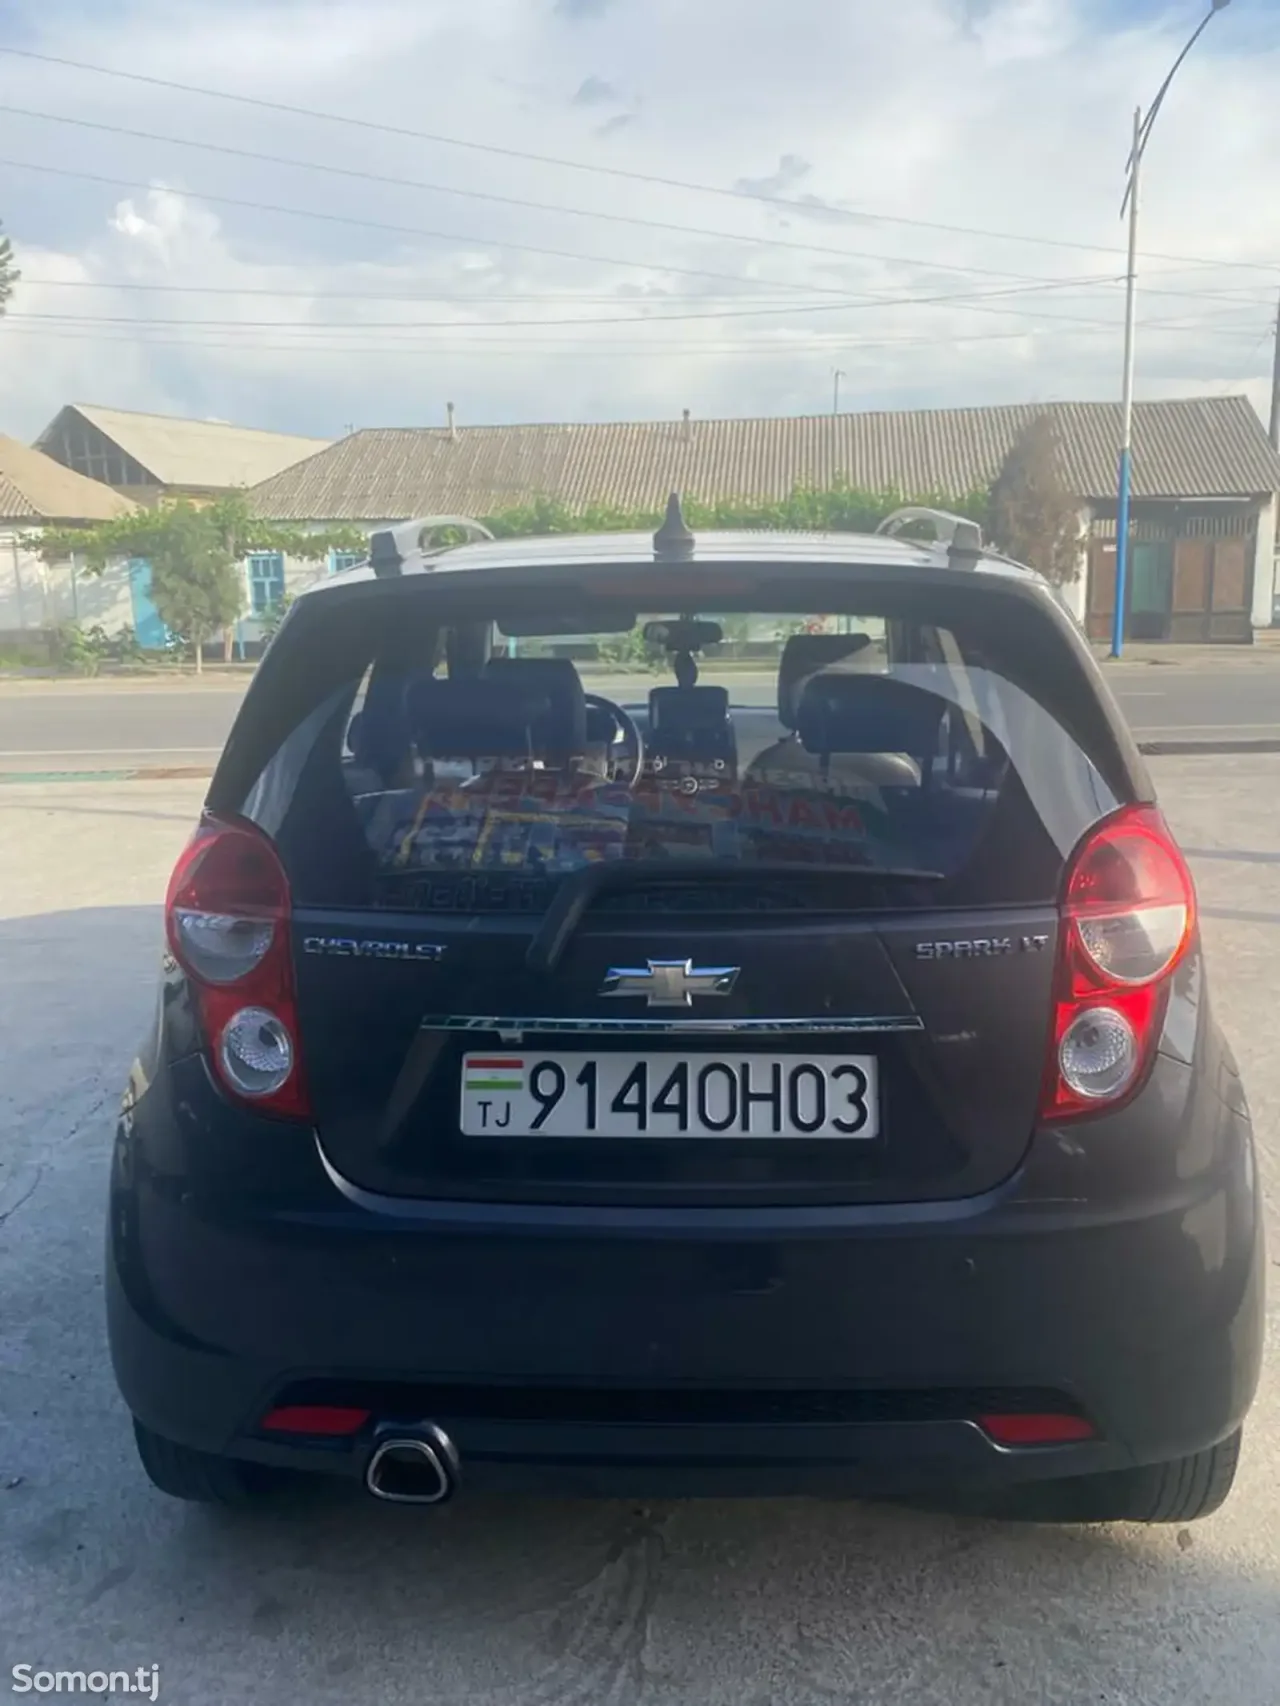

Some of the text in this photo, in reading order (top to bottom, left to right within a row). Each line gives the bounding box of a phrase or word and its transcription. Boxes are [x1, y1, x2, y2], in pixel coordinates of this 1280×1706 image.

[303, 936, 447, 961] CHEVROLET
[915, 934, 1049, 960] SPARK LT
[477, 1101, 511, 1128] TJ
